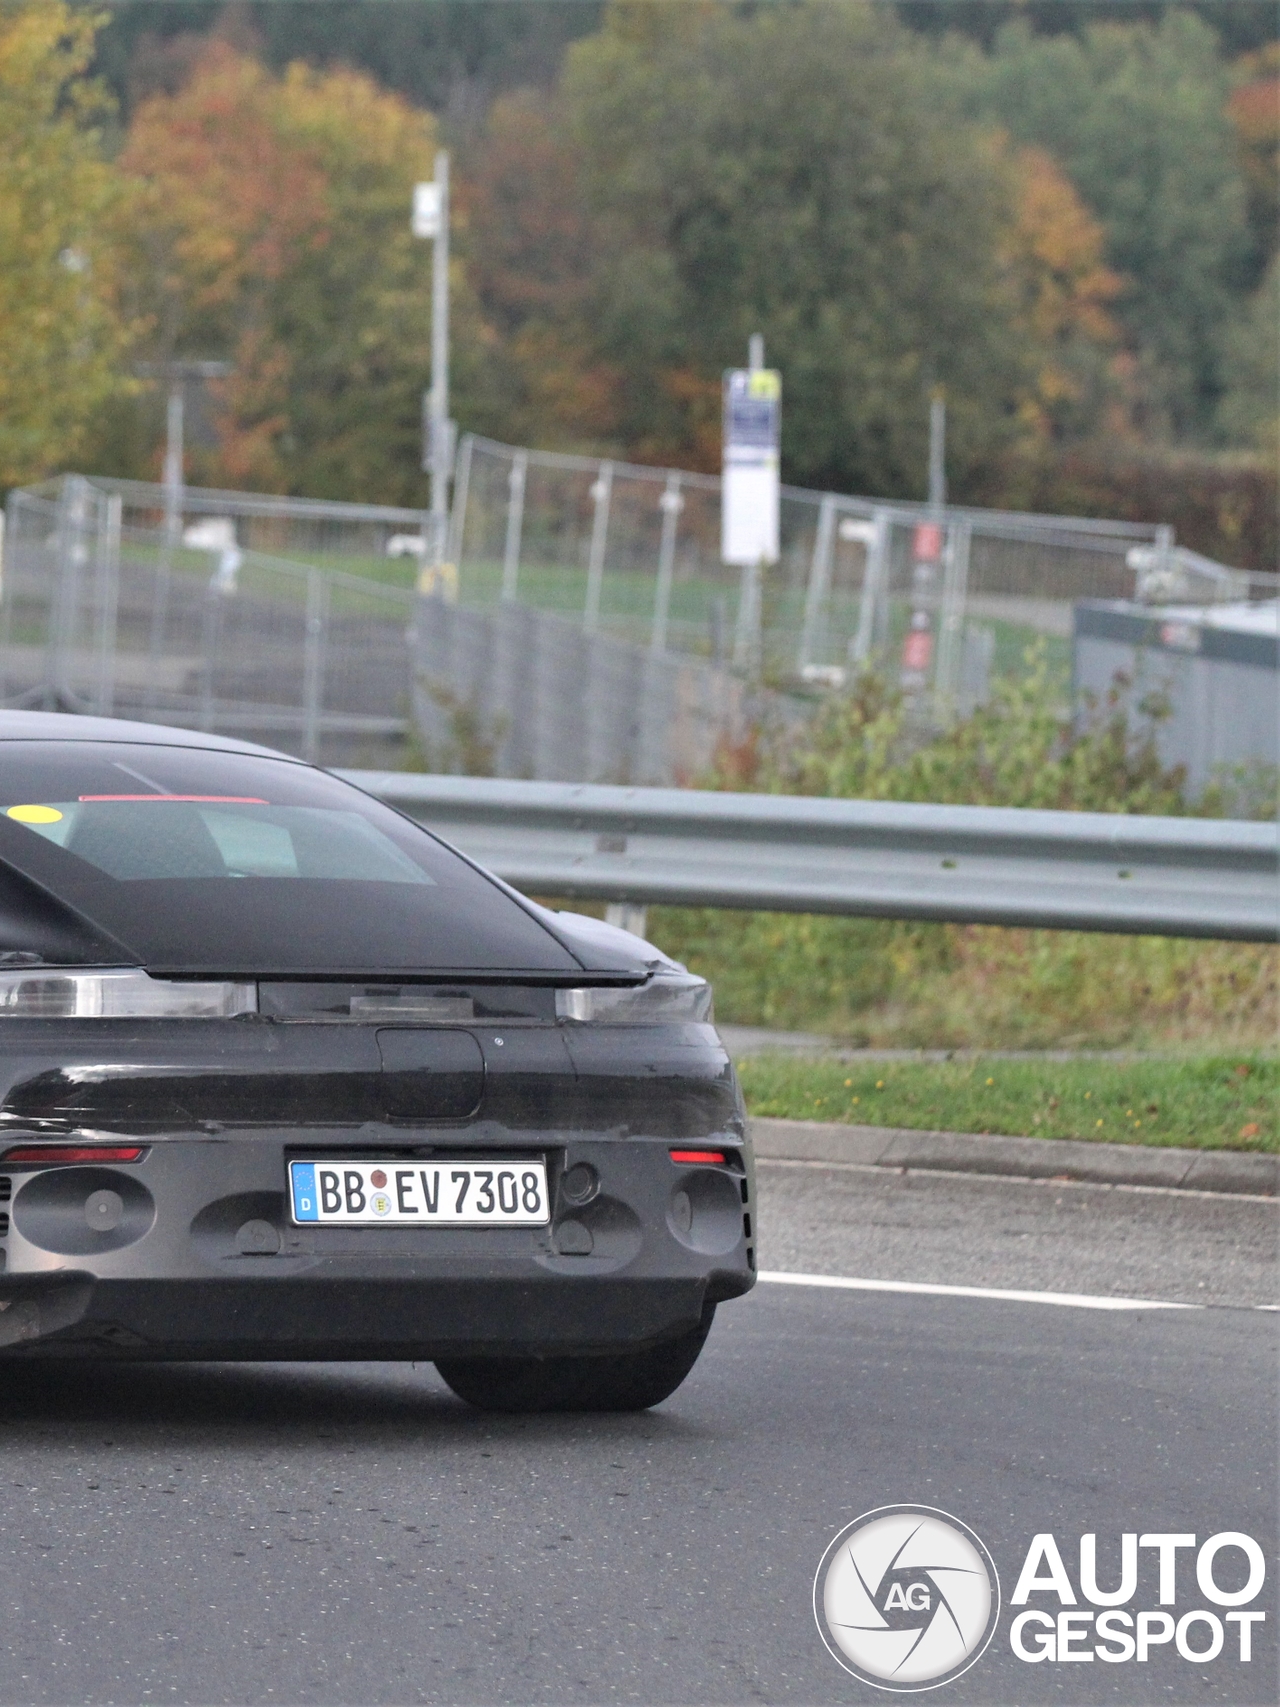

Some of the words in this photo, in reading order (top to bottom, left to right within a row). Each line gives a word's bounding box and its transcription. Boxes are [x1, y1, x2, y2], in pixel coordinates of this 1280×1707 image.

[301, 1197, 311, 1211] D
[319, 1170, 366, 1214] BB
[395, 1170, 440, 1214] EV
[451, 1170, 541, 1214] 7308
